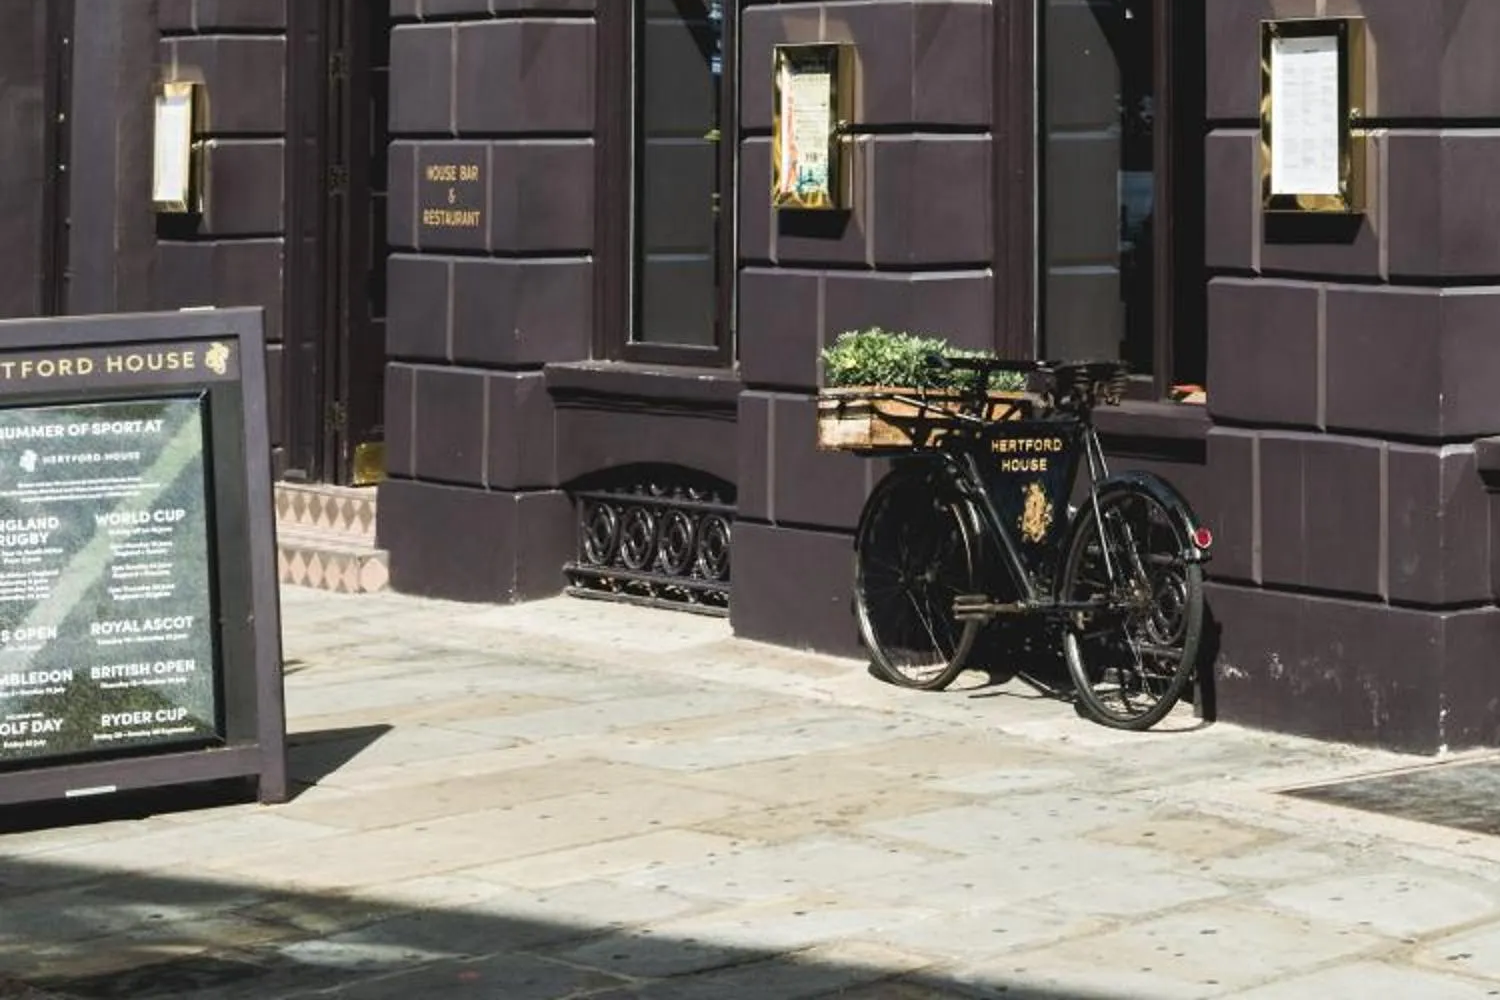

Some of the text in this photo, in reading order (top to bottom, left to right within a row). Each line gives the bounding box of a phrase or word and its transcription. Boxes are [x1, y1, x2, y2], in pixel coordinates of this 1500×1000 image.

[426, 165, 479, 181] HOUSE BAR
[423, 209, 480, 227] RESTAURANT
[107, 351, 196, 373] HOUSE
[67, 423, 89, 437] OF
[91, 420, 143, 435] SPORT
[144, 418, 165, 433] AT
[991, 438, 1063, 453] HERTFORD
[1002, 458, 1048, 472] HOUSE
[95, 508, 186, 526] WORLD CUP
[13, 625, 58, 641] OPEN
[90, 616, 194, 636] ROYAL ASCOT
[90, 659, 195, 680] BRITISH OPEN
[101, 707, 188, 727] RYDER CUP
[31, 719, 64, 734] DAY
